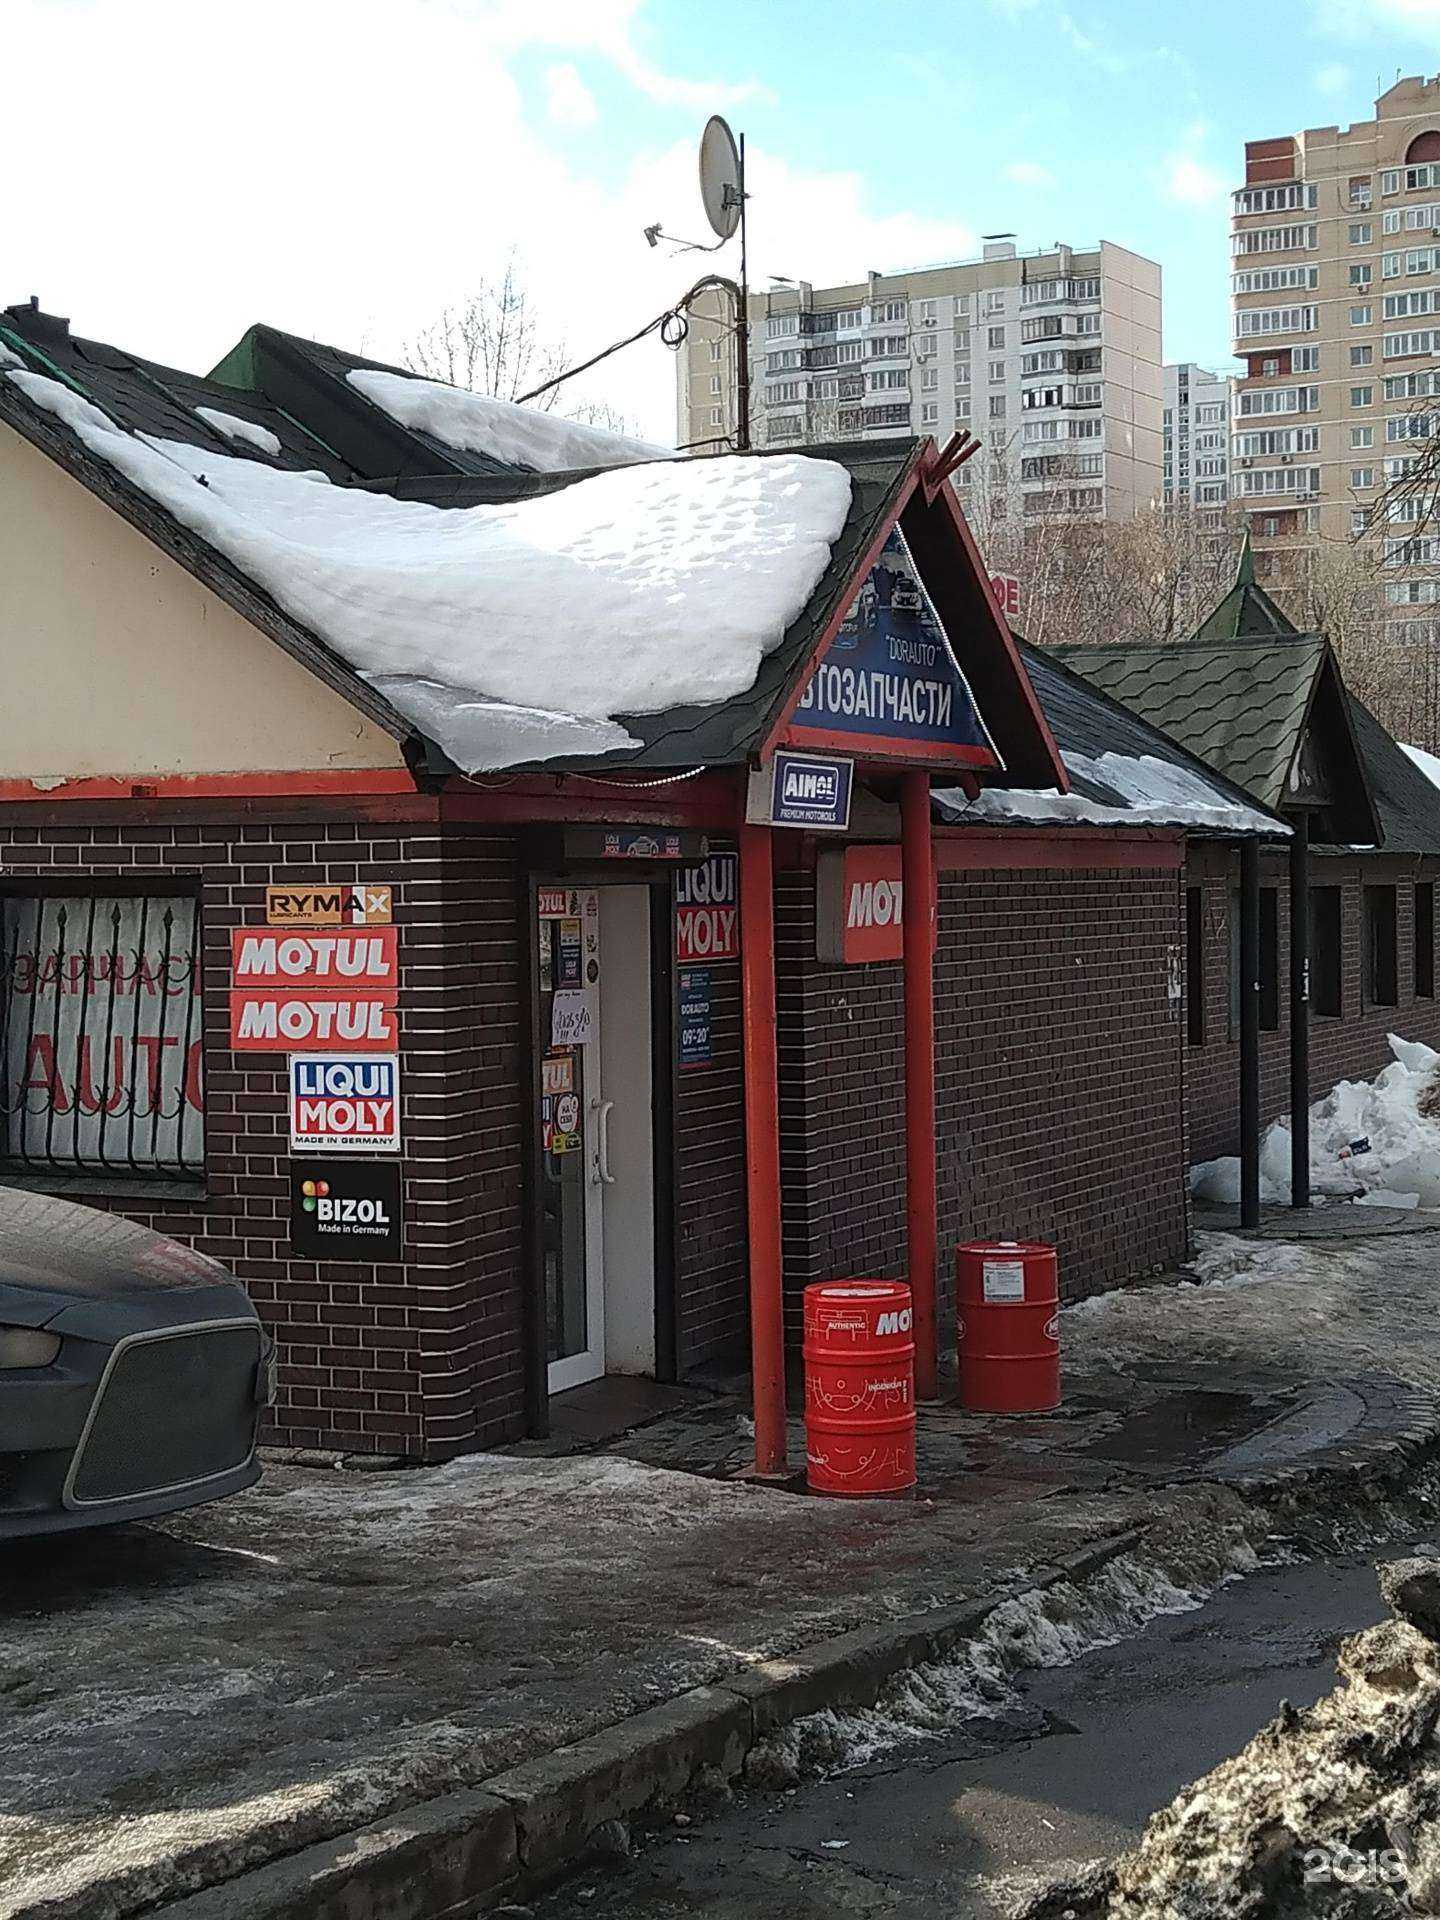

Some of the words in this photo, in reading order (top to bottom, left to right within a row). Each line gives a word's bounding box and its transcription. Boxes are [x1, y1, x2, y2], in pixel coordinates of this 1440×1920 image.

[798, 663, 952, 727] ВТОЗАПЧАСТИ
[785, 773, 835, 800] AIMOL
[676, 859, 734, 904] LIQUI
[269, 894, 389, 913] RYMAX
[677, 909, 736, 955] MOLY
[236, 937, 390, 977] MOTUL
[237, 1000, 391, 1040] MOTUL
[300, 1064, 389, 1098] LIQUI
[299, 1100, 393, 1133] MOLY
[341, 1137, 394, 1145] GERMANY
[317, 1198, 390, 1223] BIZOL
[318, 1223, 341, 1233] Made
[343, 1223, 351, 1233] in
[353, 1224, 390, 1237] Germany
[876, 1308, 912, 1336] MO
